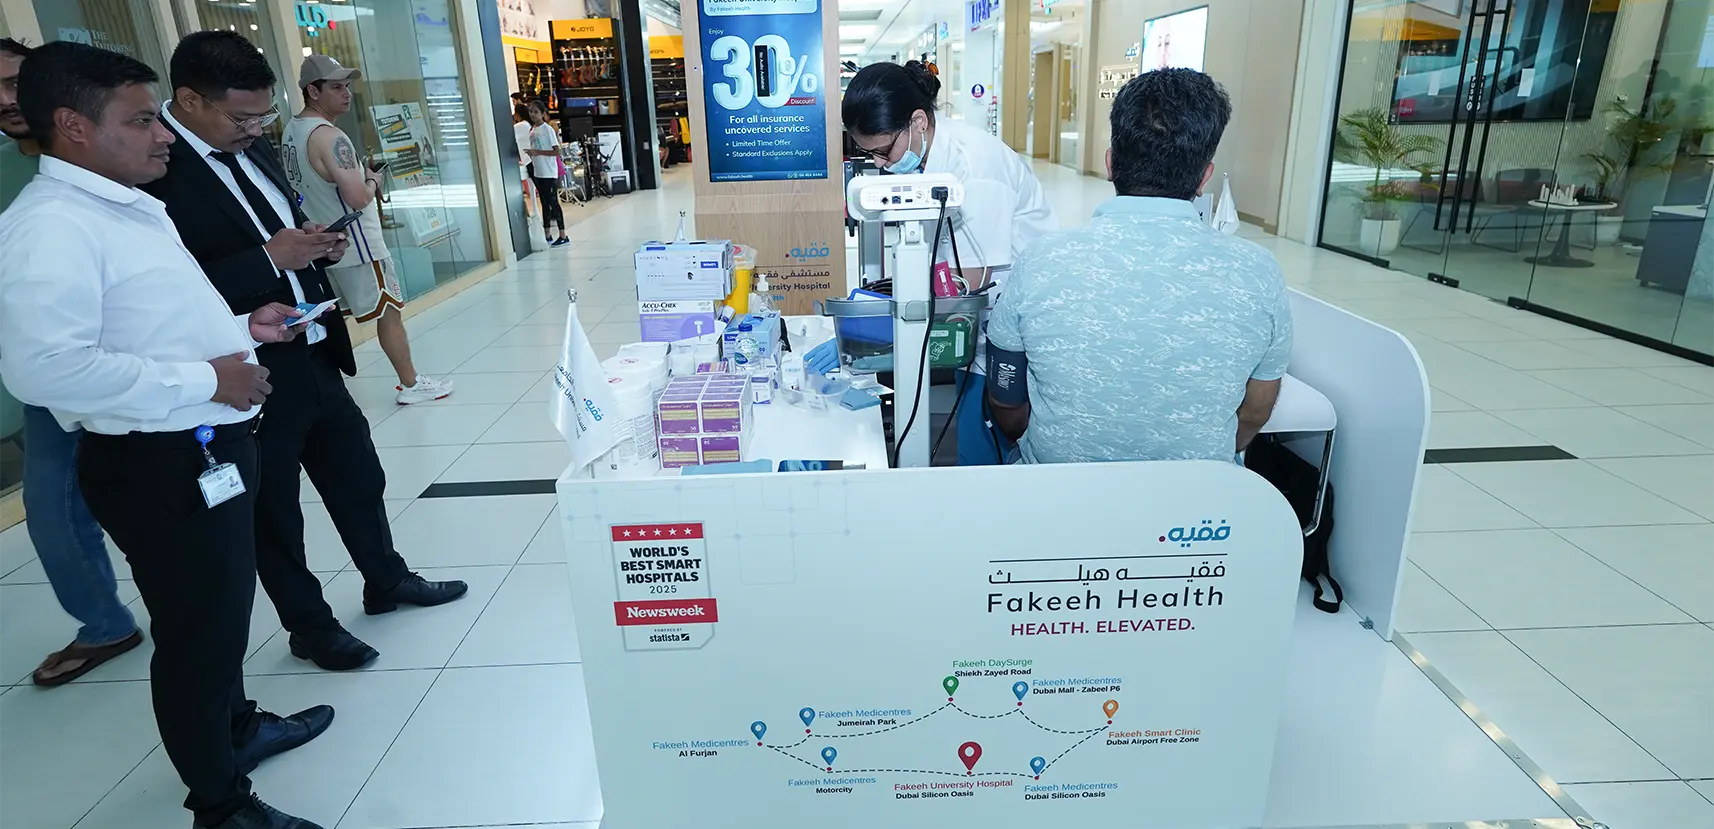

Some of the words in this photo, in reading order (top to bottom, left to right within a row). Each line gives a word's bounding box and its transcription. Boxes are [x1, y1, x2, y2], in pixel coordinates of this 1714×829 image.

[710, 34, 818, 110] 30%
[747, 115, 758, 123] all
[725, 126, 772, 135] uncovered
[774, 125, 810, 133] services
[781, 269, 830, 279] مستشفى
[794, 282, 830, 290] Hospital
[630, 546, 689, 558] WORLD'S
[621, 560, 654, 571] BEST
[656, 559, 702, 570] SMART
[626, 572, 699, 584] HOSPITALS
[649, 585, 677, 594] 2025
[987, 590, 1101, 613] Fakeeh
[1118, 586, 1223, 609] Health
[627, 605, 705, 618] Newsweek
[1011, 622, 1090, 636] HEALTH.
[1097, 618, 1195, 633] ELEVATED.
[650, 633, 680, 642] statista
[953, 660, 986, 668] Fakeeh
[989, 658, 1033, 667] DaySurge
[1032, 678, 1066, 686] Fakeeh
[1068, 676, 1122, 685] Medicentres
[819, 710, 852, 719] Fakeeh
[855, 708, 911, 718] Medicentres
[1108, 730, 1142, 738] Fakeeh
[1144, 729, 1172, 737] Smart
[653, 741, 688, 750] Fakeeh
[691, 738, 749, 748] Medicentres
[1131, 737, 1158, 746] Airport
[689, 749, 718, 758] Furjan
[823, 776, 876, 785] Medicentres
[930, 781, 974, 790] University
[976, 779, 1013, 789] Hospital
[816, 787, 853, 795] Motorcity
[1025, 784, 1059, 792] Fakeeh
[1062, 781, 1118, 791] Medicentres
